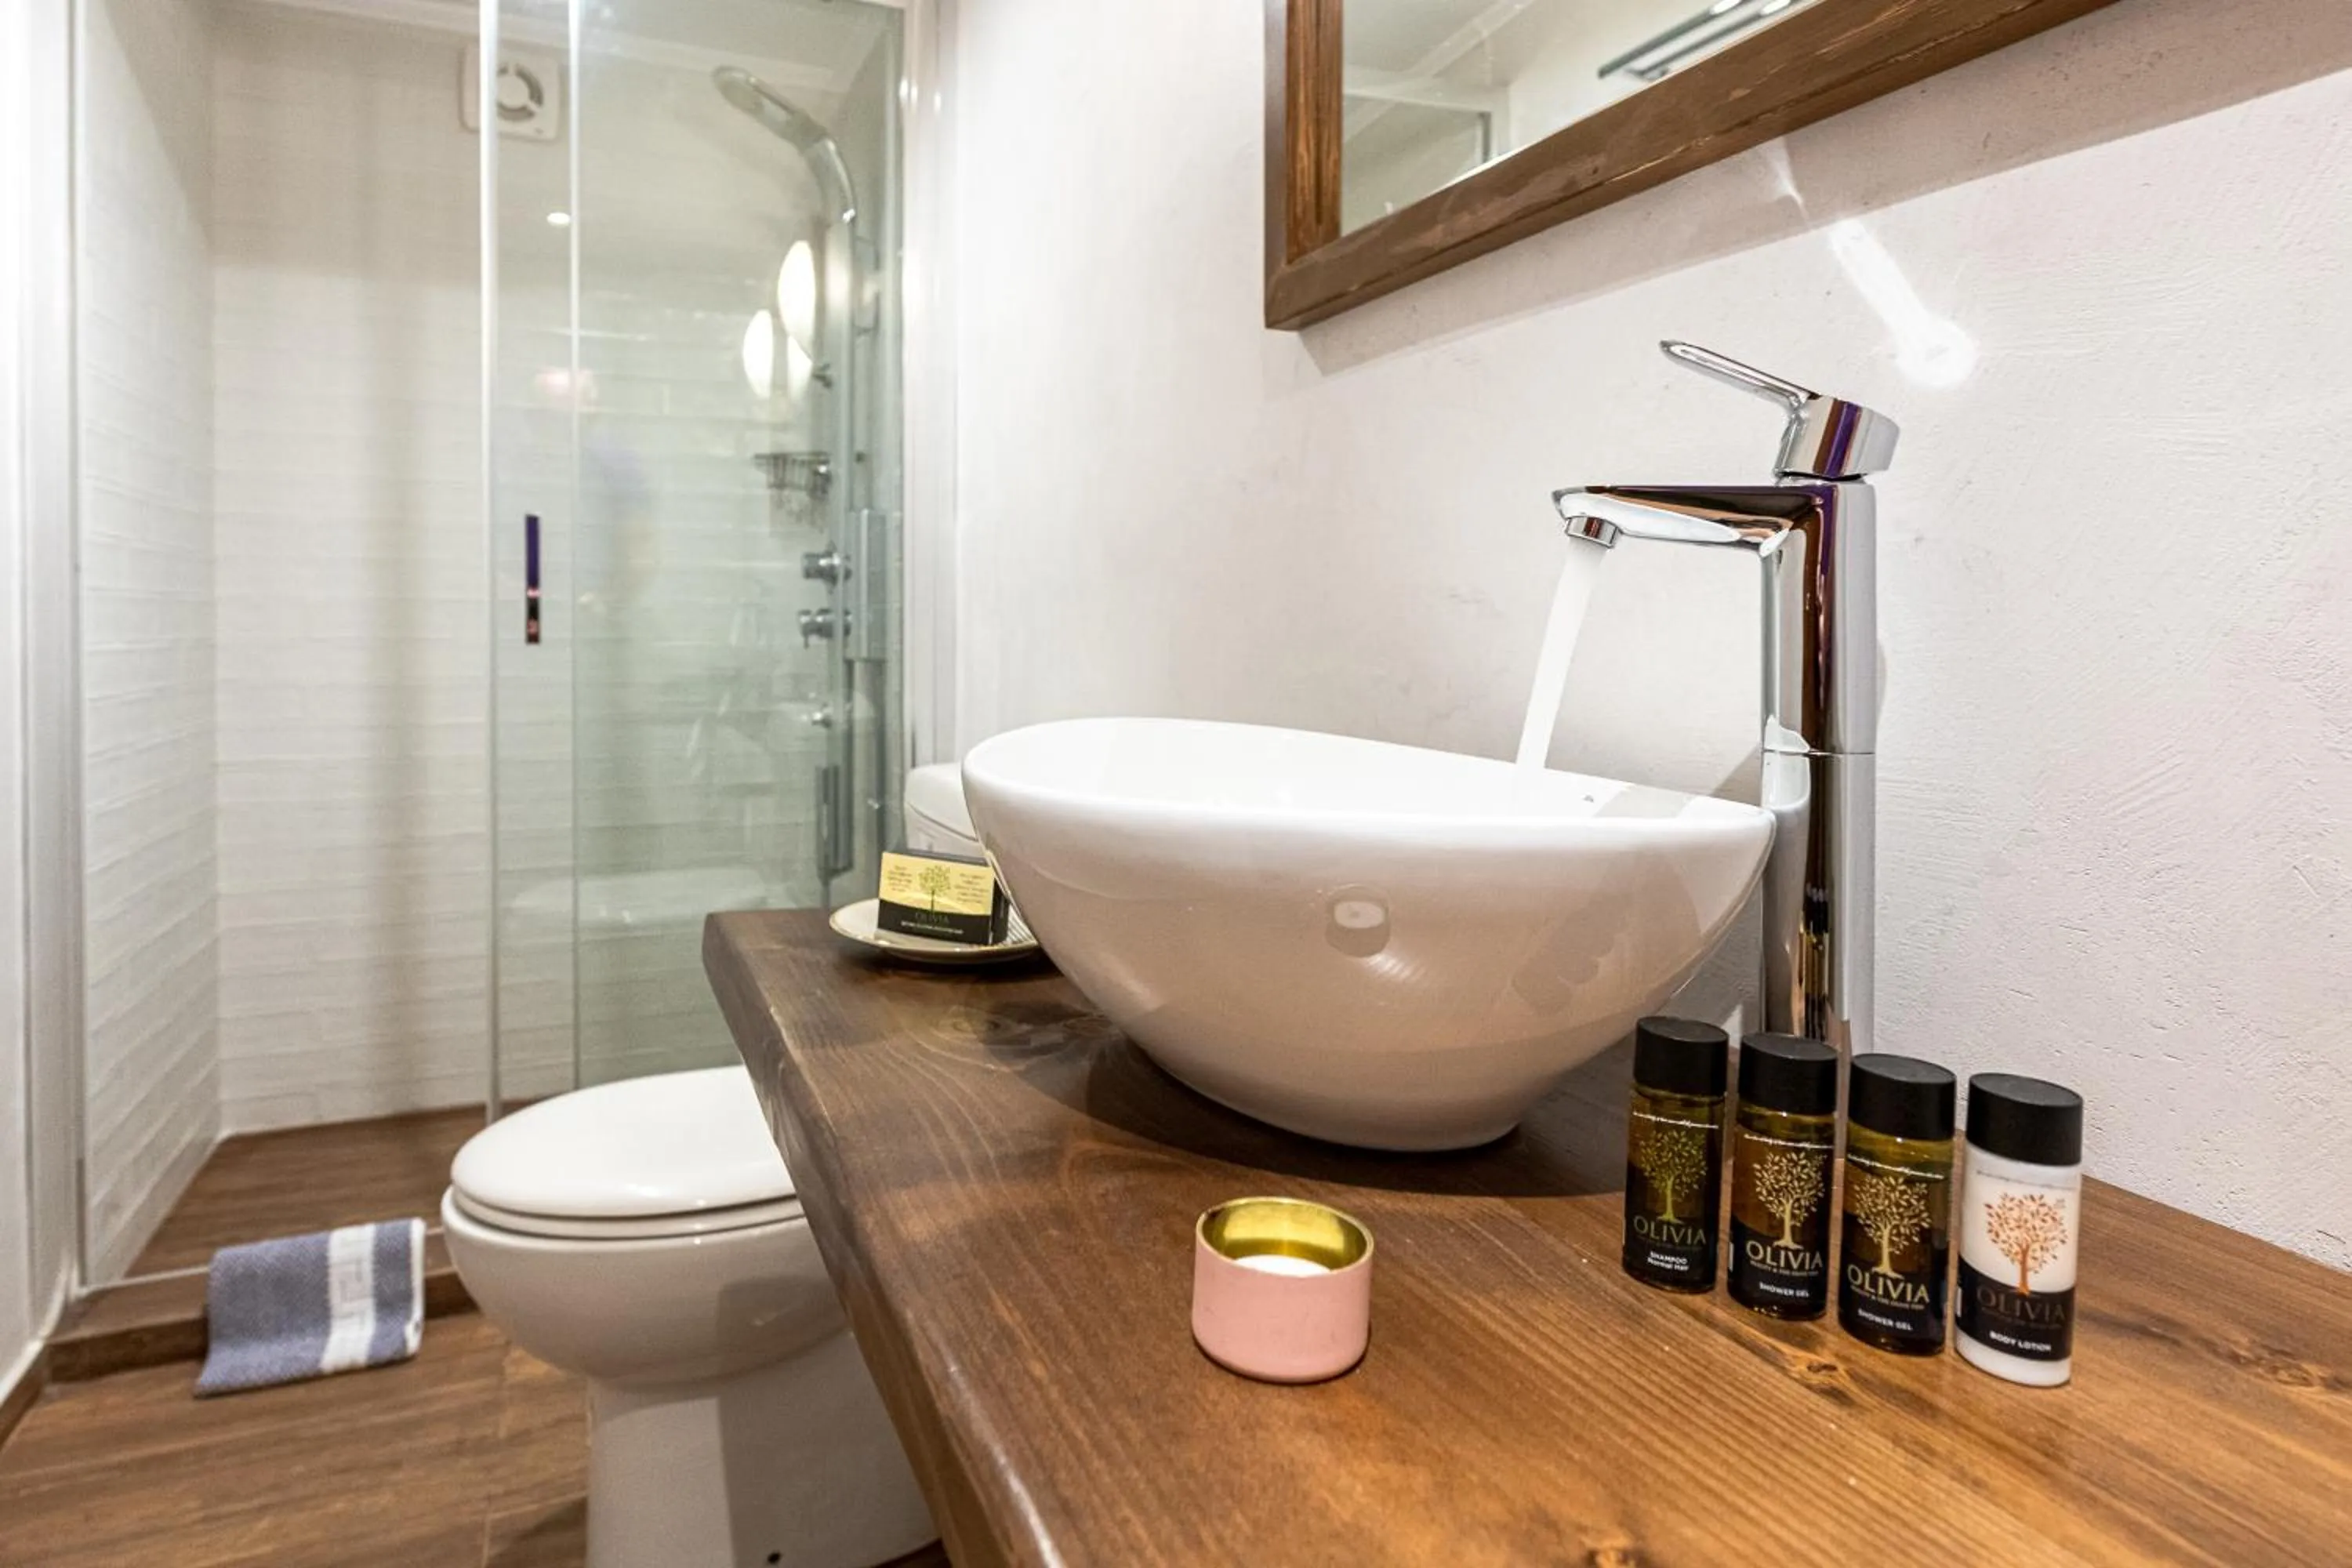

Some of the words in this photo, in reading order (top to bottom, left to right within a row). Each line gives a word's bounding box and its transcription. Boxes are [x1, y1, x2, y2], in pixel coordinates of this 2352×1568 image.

[1633, 1215, 1707, 1245] OLIVIA
[1650, 1250, 1688, 1265] SHAMPOO
[1746, 1240, 1823, 1270] OLIVIA
[1847, 1264, 1930, 1304] OLIVIA
[1976, 1284, 2066, 1322] OLIVIA
[1857, 1308, 1894, 1327] SHOWER
[1894, 1320, 1913, 1331] GEL
[1989, 1330, 2016, 1347] BODY
[2017, 1339, 2052, 1352] LOTION
